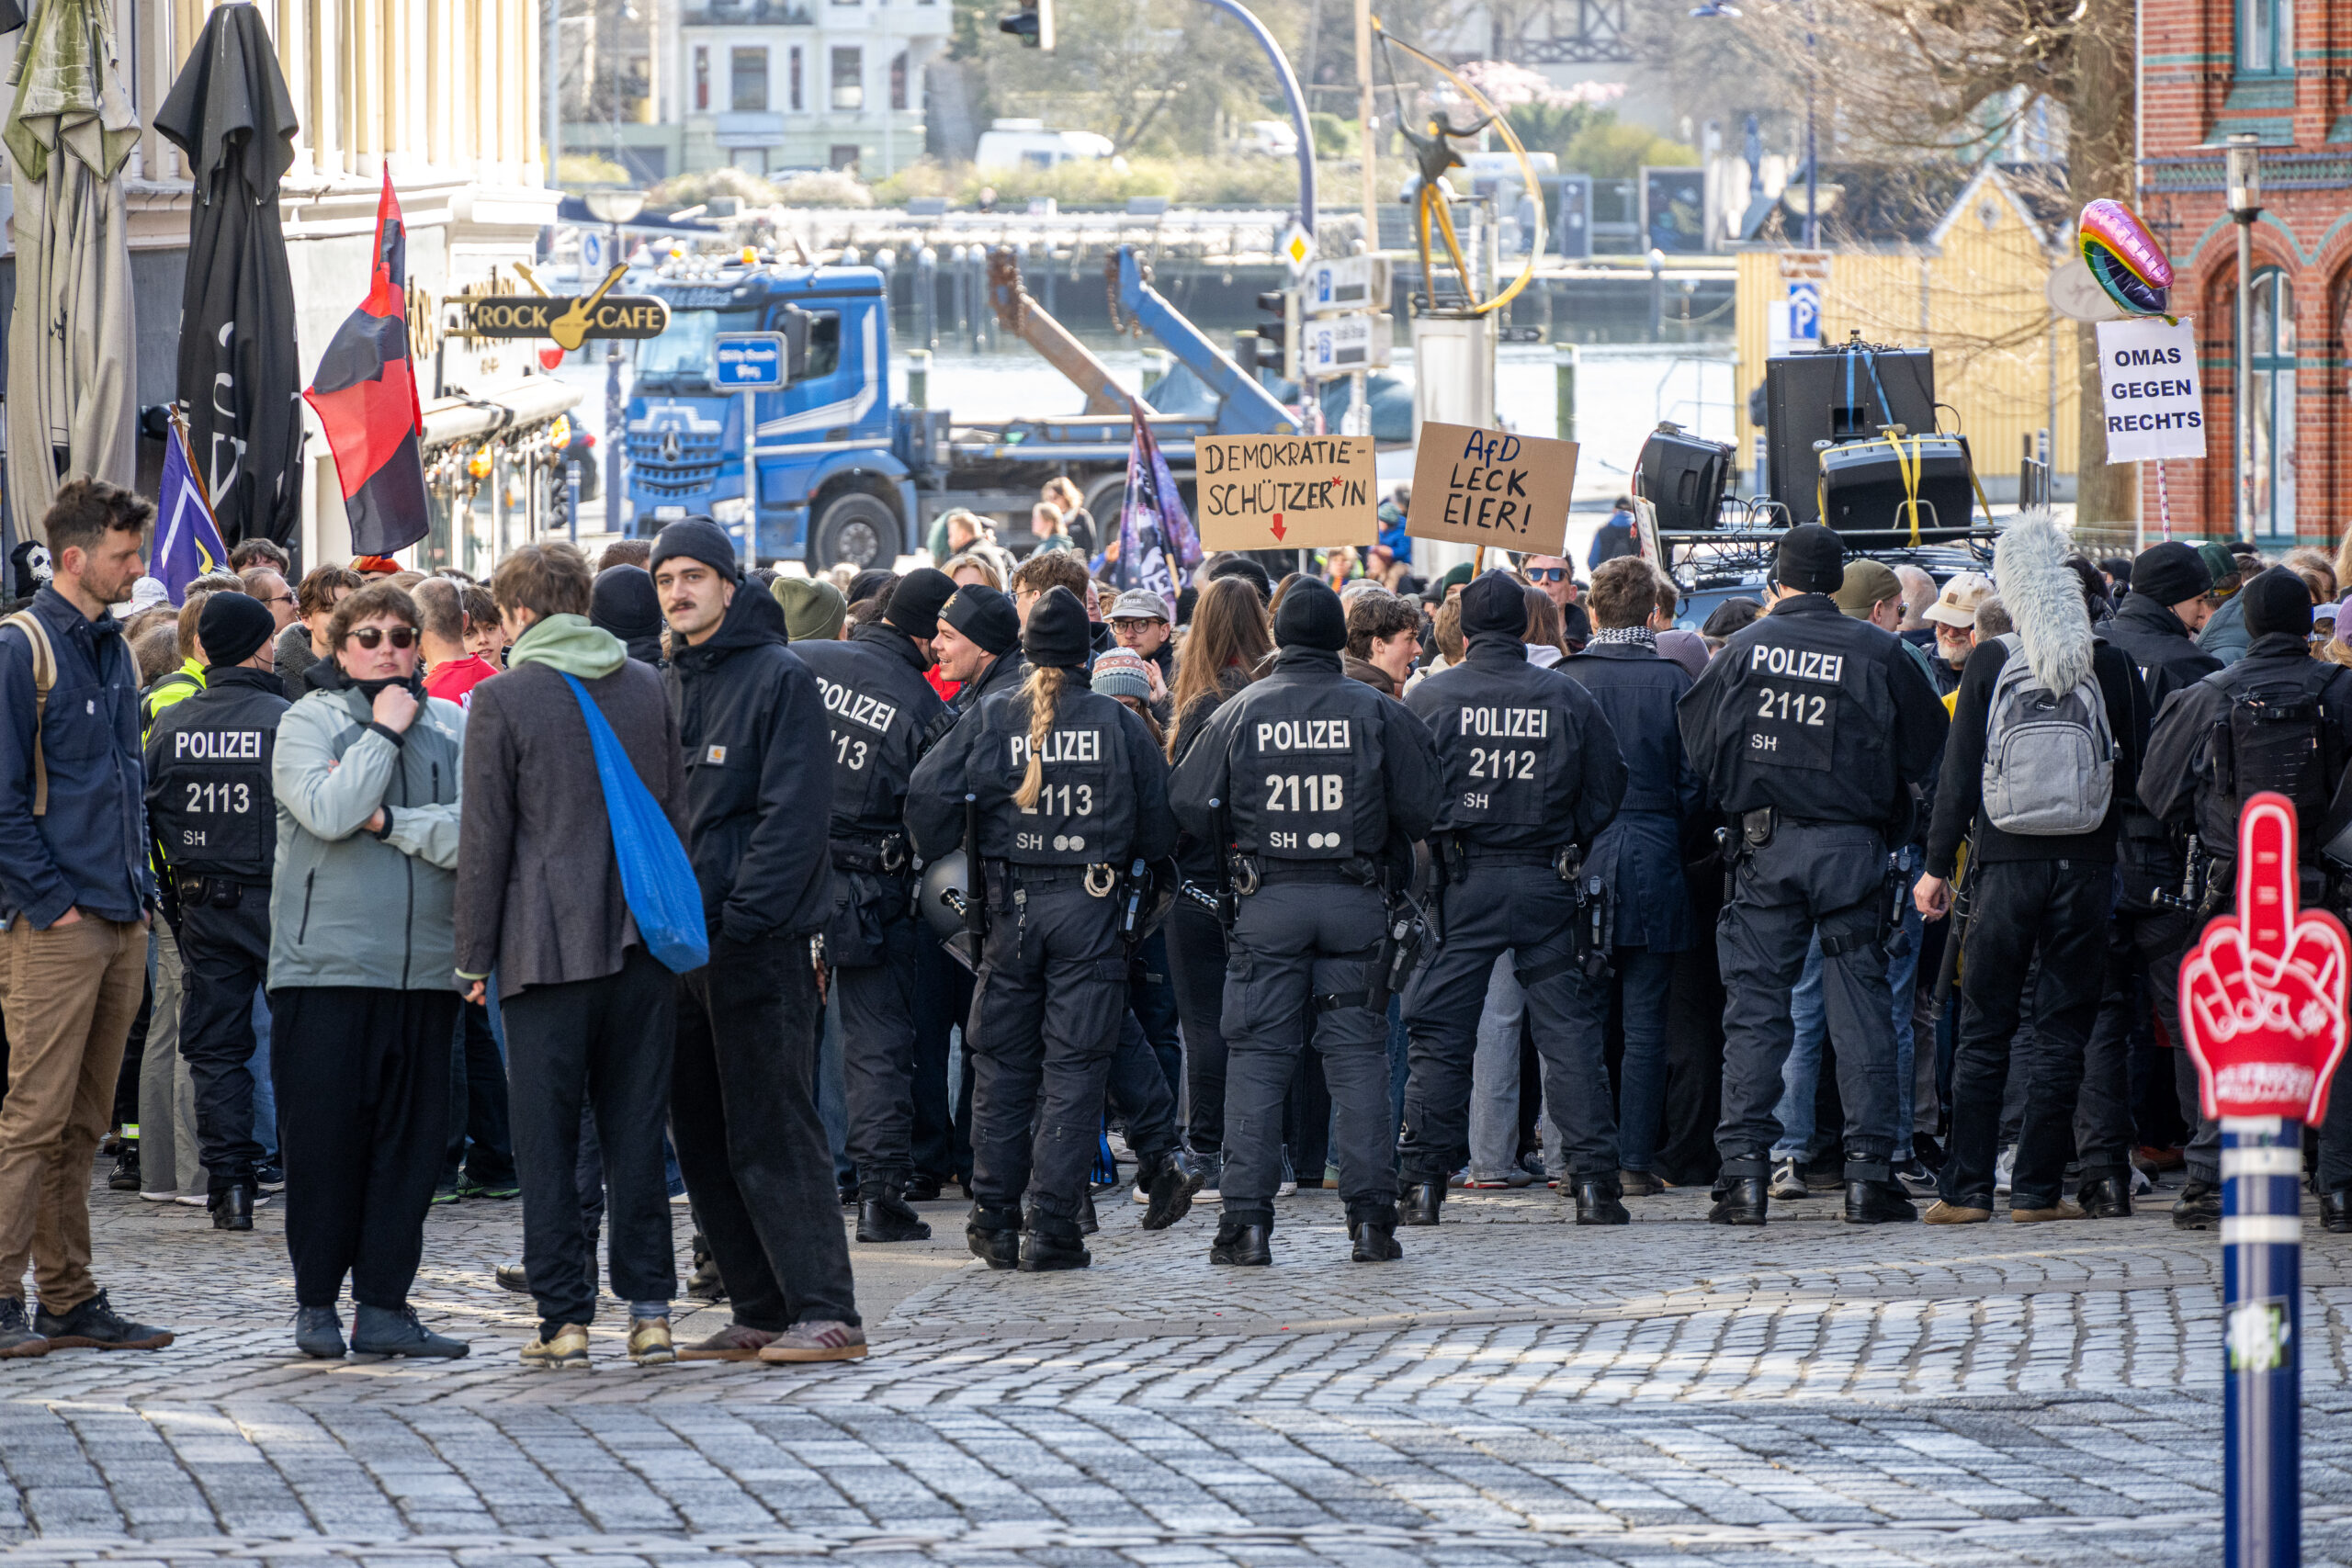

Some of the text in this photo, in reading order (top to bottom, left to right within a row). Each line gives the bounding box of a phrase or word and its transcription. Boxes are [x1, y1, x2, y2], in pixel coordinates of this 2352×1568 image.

[478, 305, 661, 330] ROCK CAFE
[2114, 347, 2182, 367] OMAS
[2111, 378, 2192, 400] GEGEN
[2108, 411, 2201, 433] RECHTS
[1464, 429, 1521, 468] AfD
[1450, 462, 1529, 498] LECK
[1443, 493, 1532, 535] EIER!
[1751, 644, 1843, 682] POLIZEI
[1461, 706, 1548, 738] POLIZEI
[1758, 687, 1826, 726] 2112
[175, 731, 262, 759] POLIZEI
[1257, 719, 1351, 751] POLIZEI
[1751, 733, 1777, 751] SH
[1468, 747, 1536, 780] 2112
[186, 783, 250, 814] 2113
[1021, 784, 1092, 817] 113
[1265, 773, 1344, 812] 211B
[1463, 792, 1488, 809] SH
[183, 829, 206, 846] SH
[1016, 832, 1043, 851] SH
[1270, 831, 1297, 849] SH
